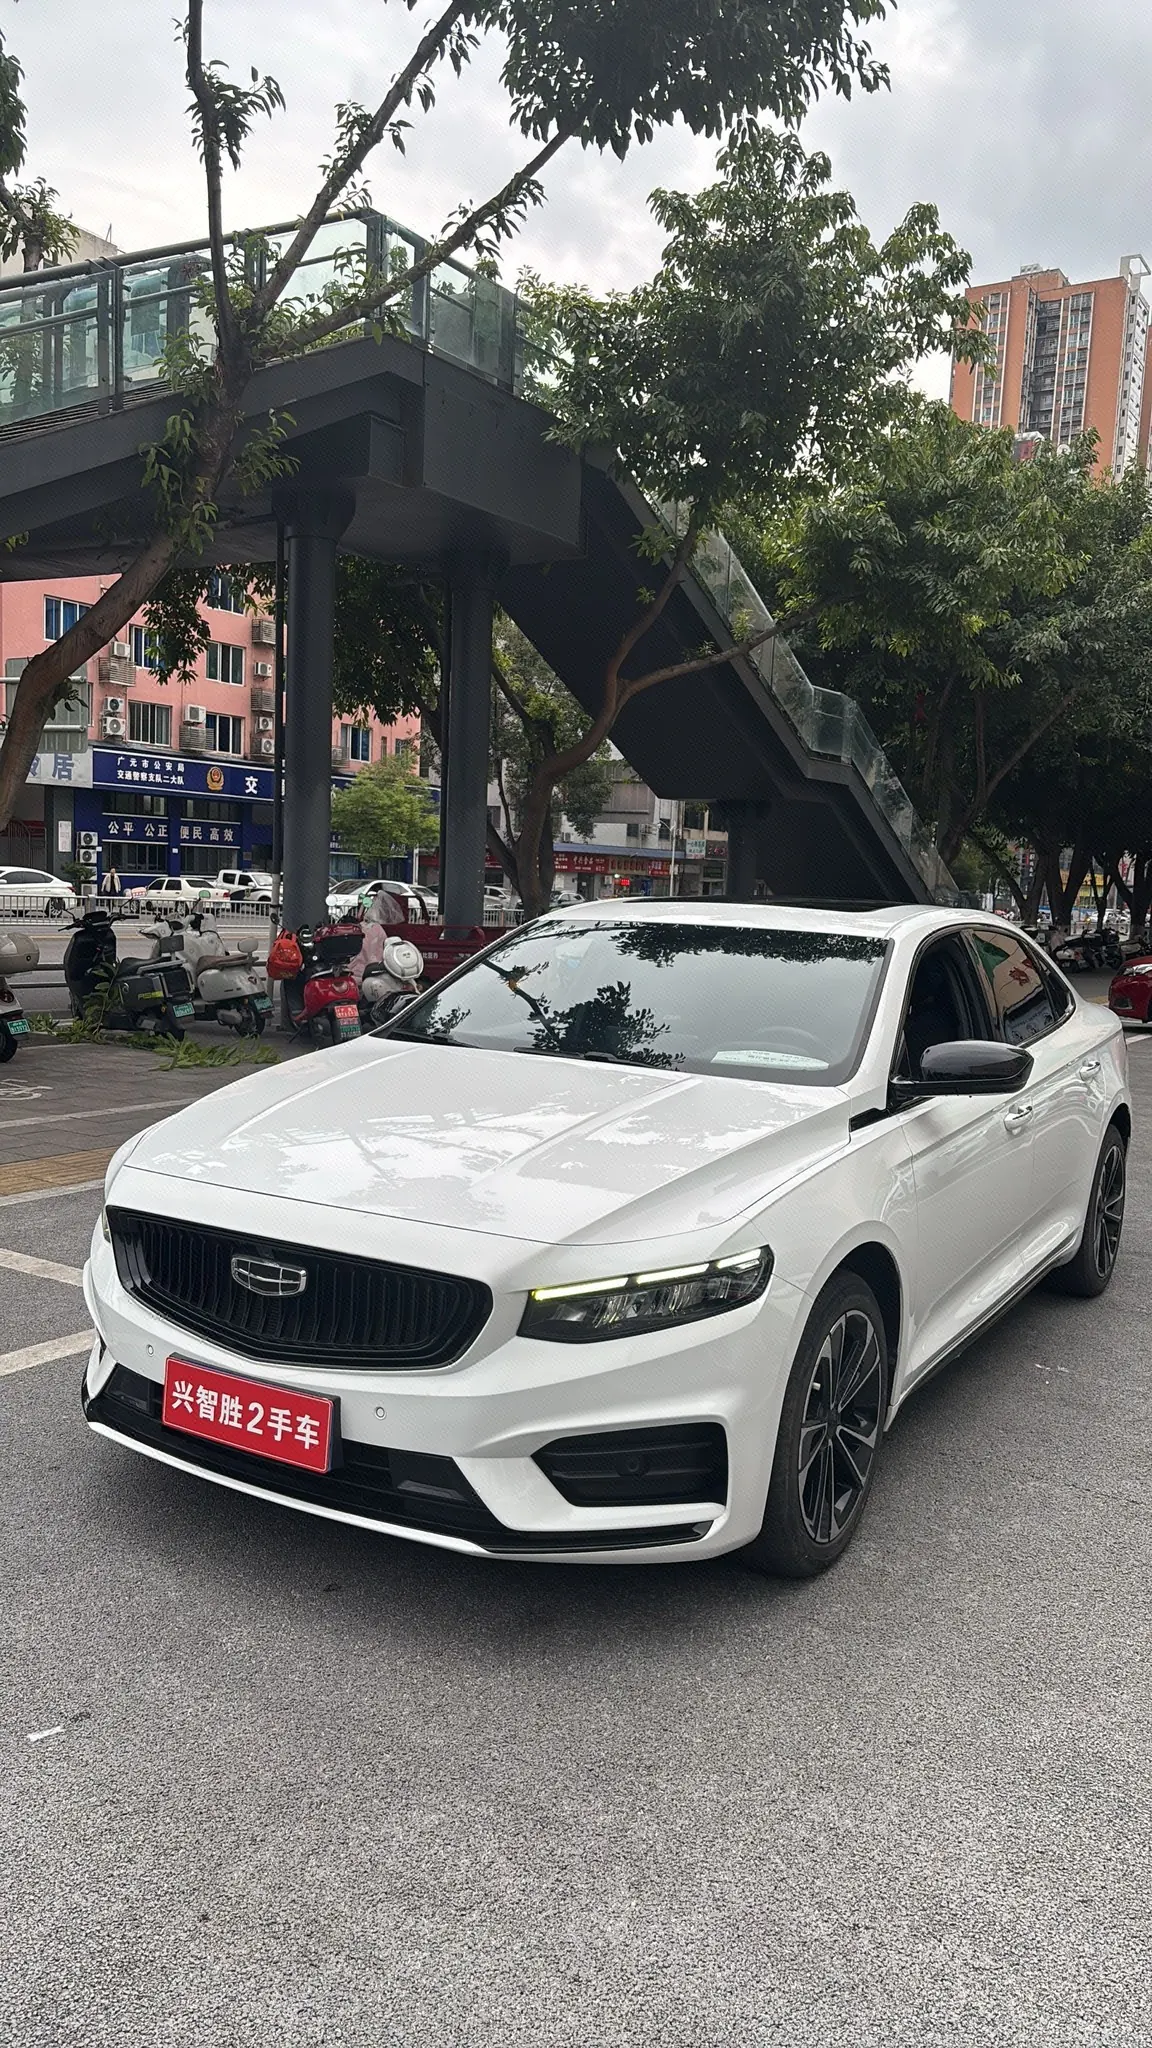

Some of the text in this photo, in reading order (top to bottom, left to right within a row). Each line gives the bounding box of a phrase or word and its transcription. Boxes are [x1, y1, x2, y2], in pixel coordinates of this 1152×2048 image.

[117, 757, 185, 772] 广元市公安局
[117, 769, 185, 785] 交通警察支队二大队
[108, 821, 234, 841] 公平 公正 便民 高效
[172, 1380, 320, 1450] 兴智胜2手车
